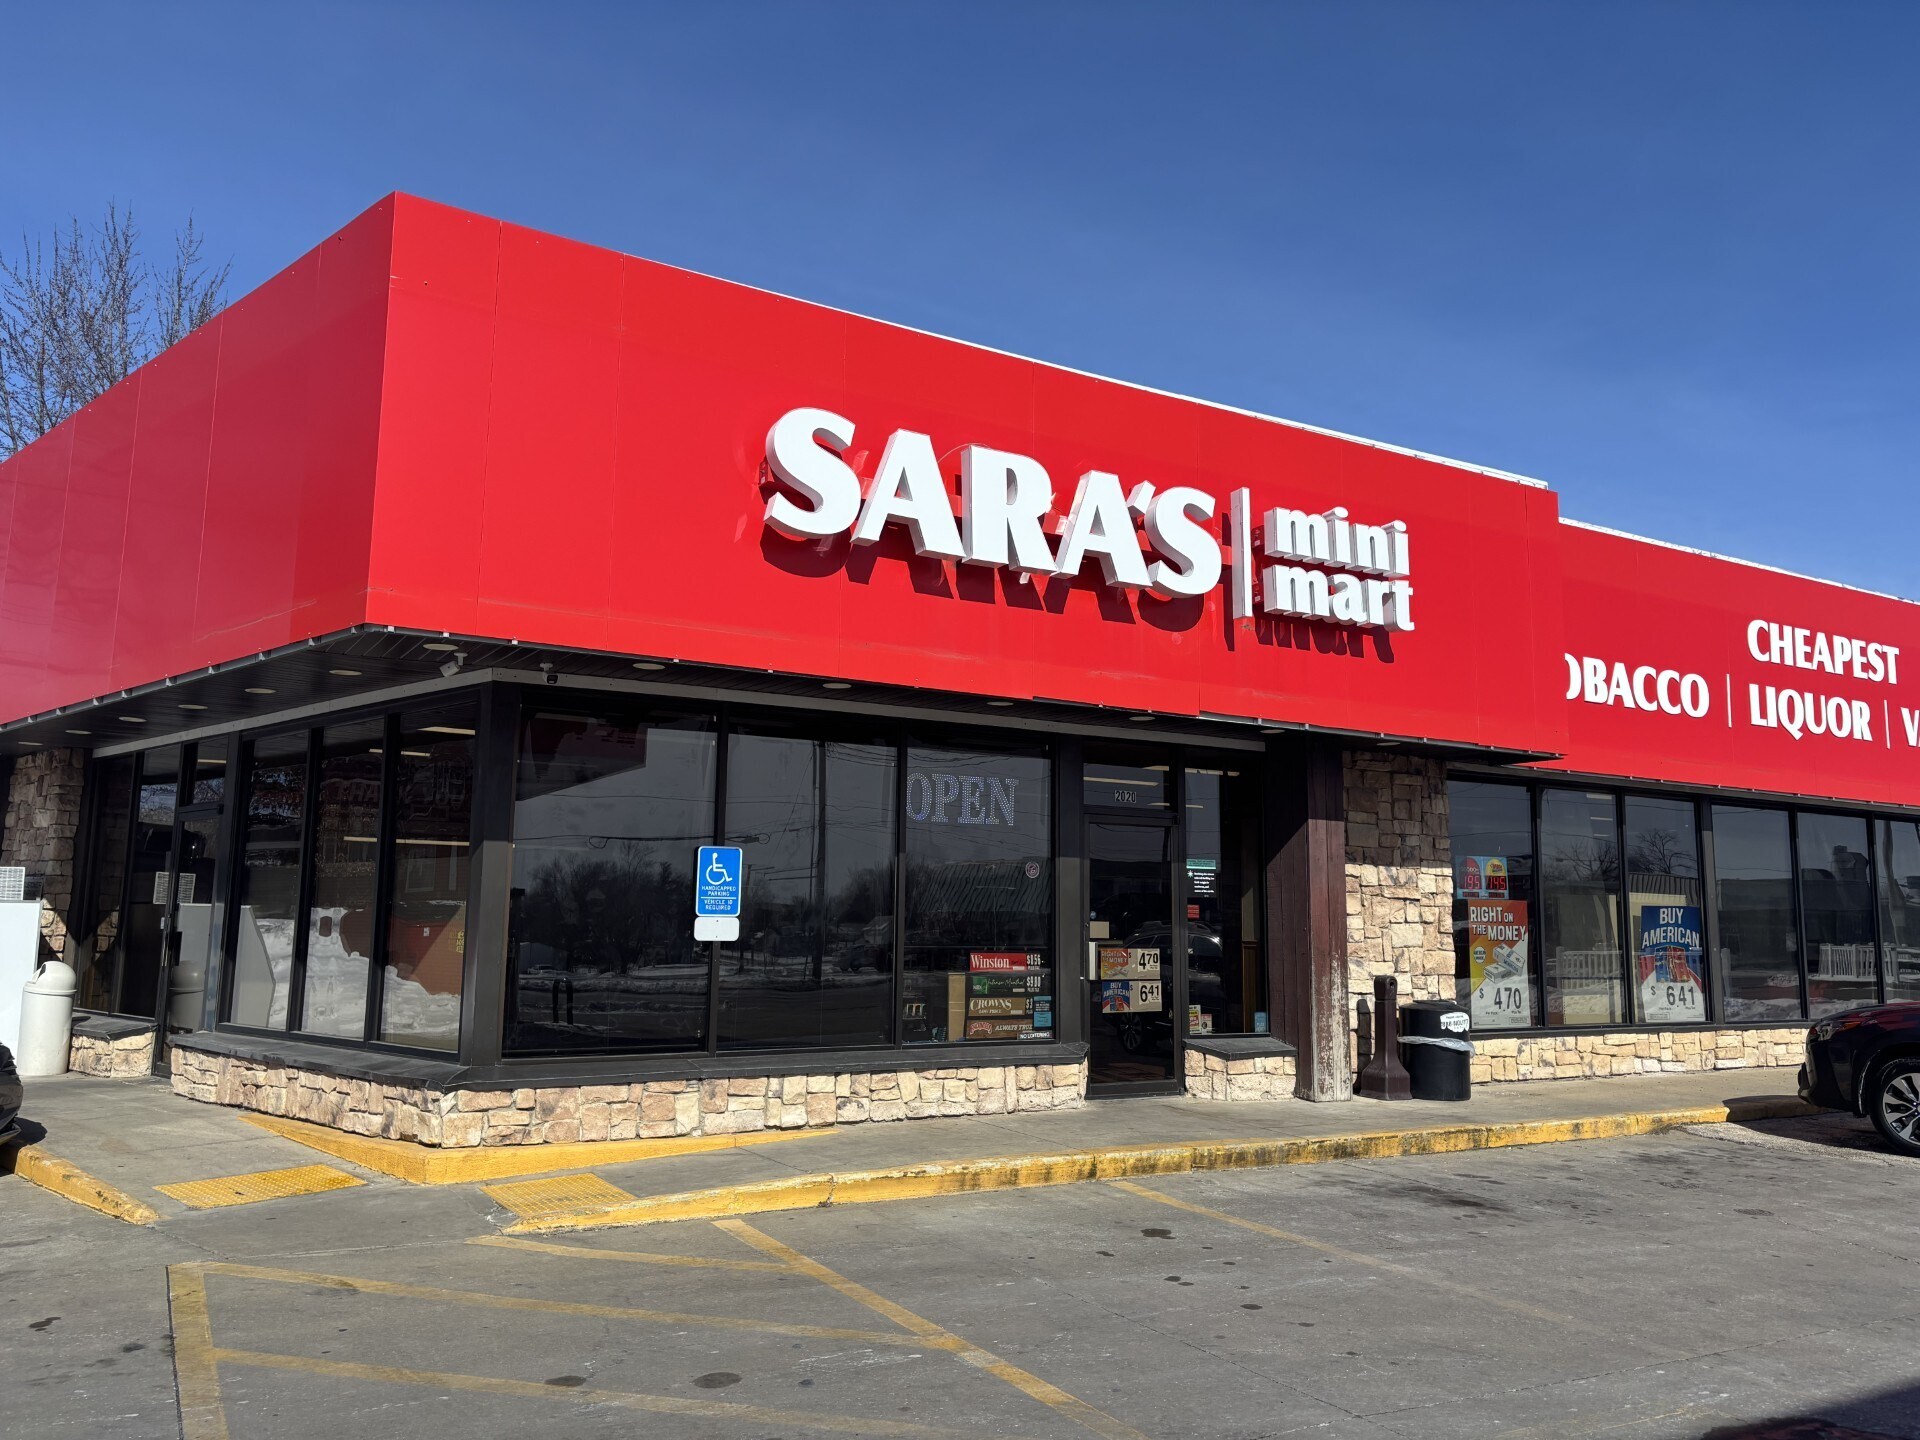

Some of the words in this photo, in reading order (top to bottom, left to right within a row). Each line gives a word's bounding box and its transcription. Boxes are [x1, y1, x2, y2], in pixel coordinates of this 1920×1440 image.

[763, 406, 1222, 599] SARA'S
[1264, 507, 1410, 578] mini
[1263, 564, 1415, 632] mart
[1747, 619, 1900, 685] CHEAPEST
[1749, 683, 1873, 740] LIQUOR
[1900, 707, 1920, 748] V
[906, 772, 1019, 826] OPEN
[1115, 790, 1136, 803] 2020
[1469, 906, 1503, 923] RIGHT
[1503, 912, 1514, 923] ON
[1659, 907, 1684, 925] BUY
[1472, 924, 1487, 935] THE
[1487, 925, 1526, 941] MONEY
[1641, 926, 1700, 950] AMERICAN
[970, 954, 1010, 969] Winston
[970, 998, 1012, 1011] CROWNS
[1103, 988, 1130, 997] AMERICAN
